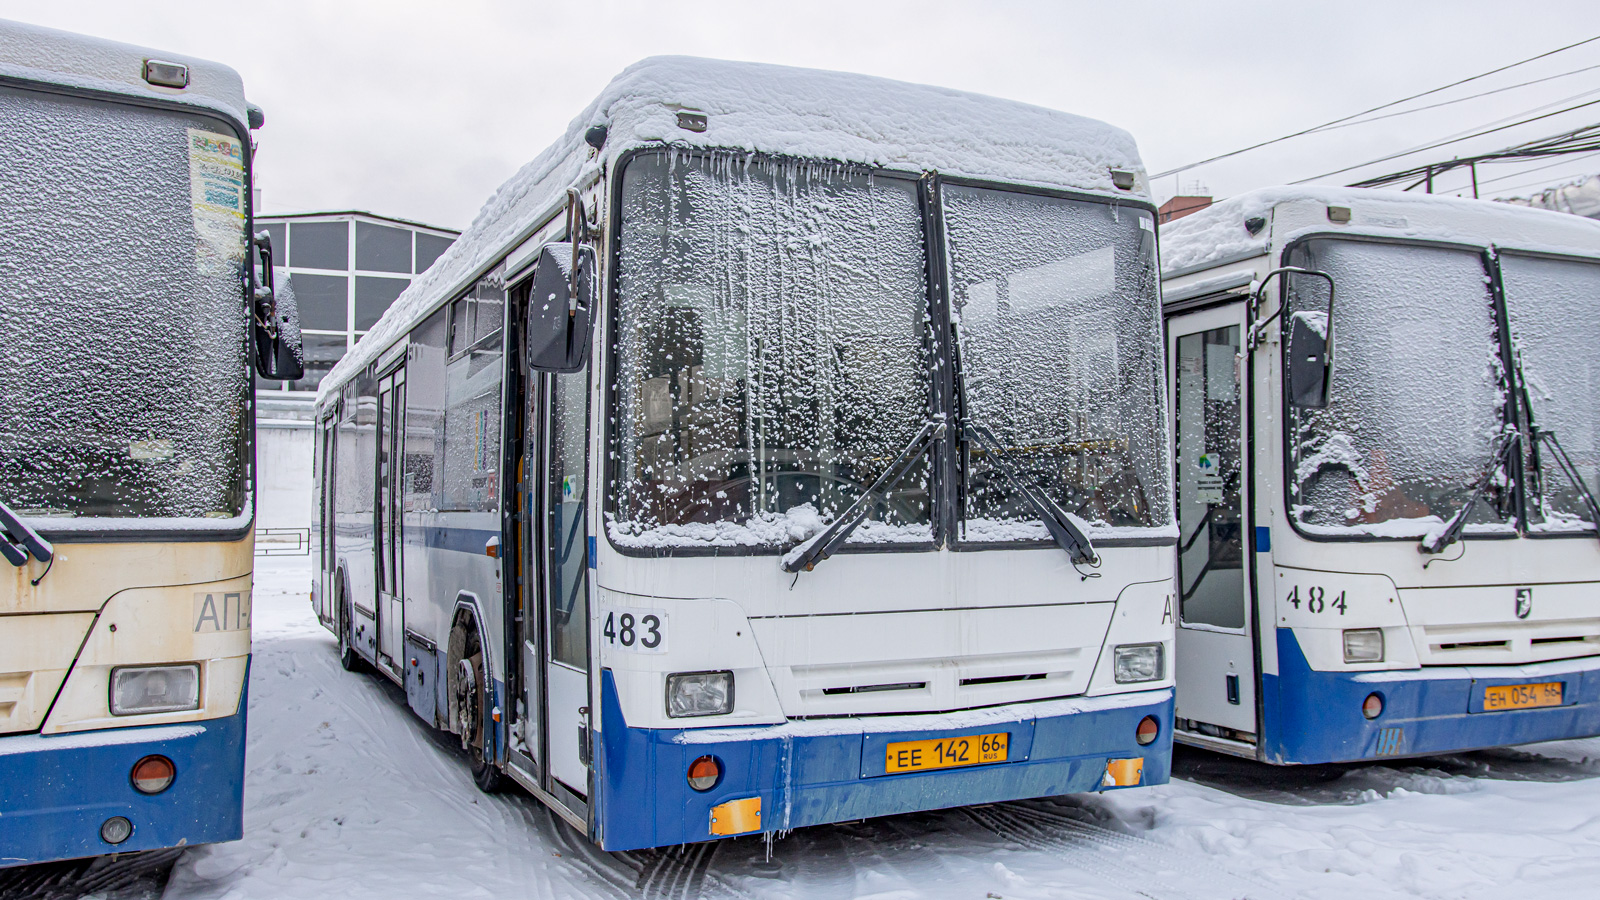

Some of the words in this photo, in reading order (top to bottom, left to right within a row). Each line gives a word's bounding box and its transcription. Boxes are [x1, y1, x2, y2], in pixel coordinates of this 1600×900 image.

[1286, 585, 1348, 616] 484
[603, 611, 662, 649] 483
[1489, 692, 1506, 707] ЕН
[1511, 686, 1538, 704] 054
[1544, 683, 1558, 697] 66
[897, 749, 922, 768] ЕЕ
[934, 740, 969, 764] 142
[981, 735, 1000, 753] 66
